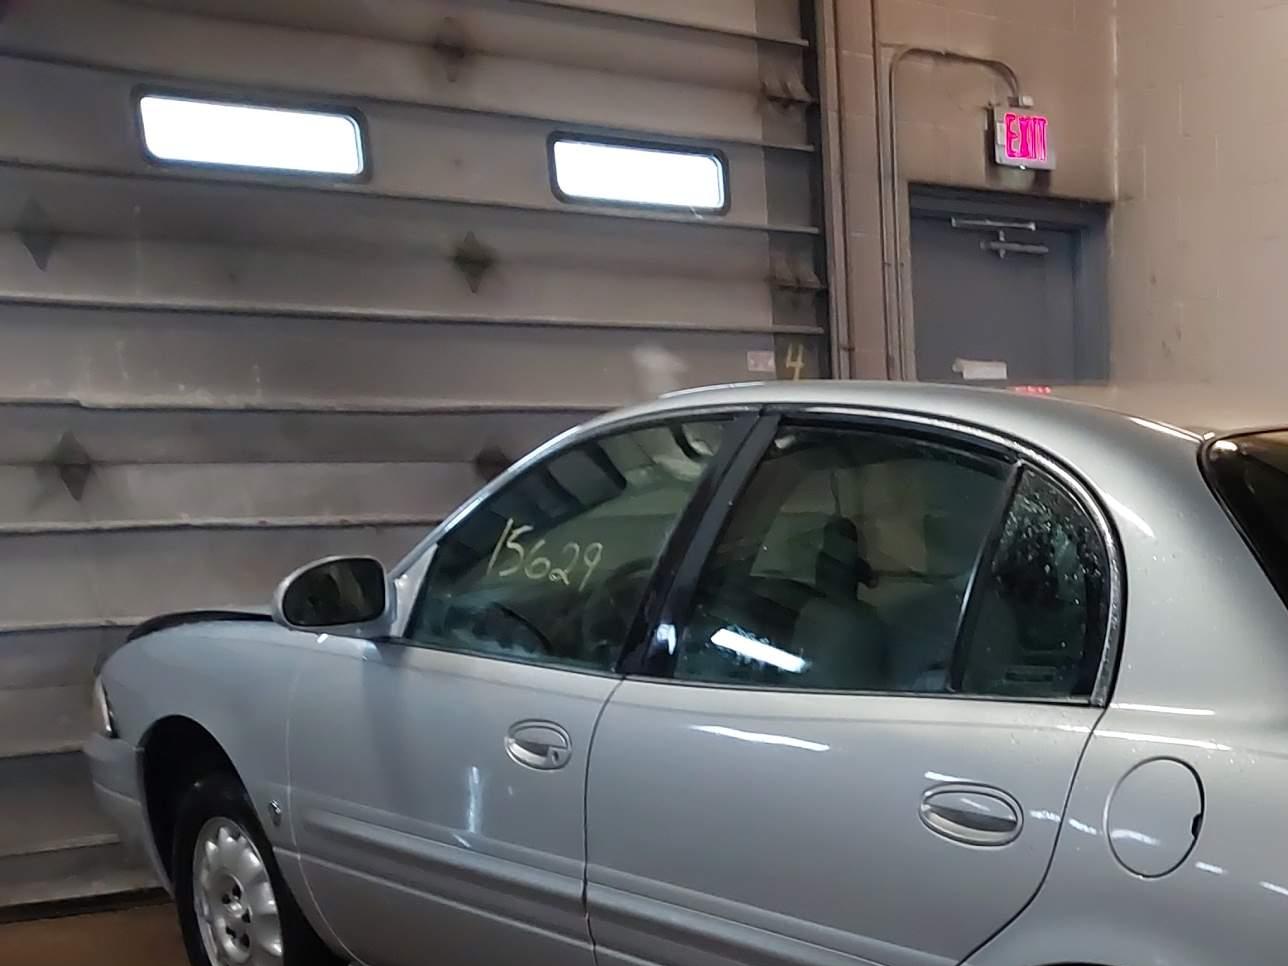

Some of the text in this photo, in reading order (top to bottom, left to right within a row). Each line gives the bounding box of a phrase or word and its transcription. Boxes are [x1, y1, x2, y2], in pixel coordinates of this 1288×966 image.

[1004, 112, 1048, 161] EXIT
[786, 343, 805, 381] 4
[486, 517, 603, 592] 15629
